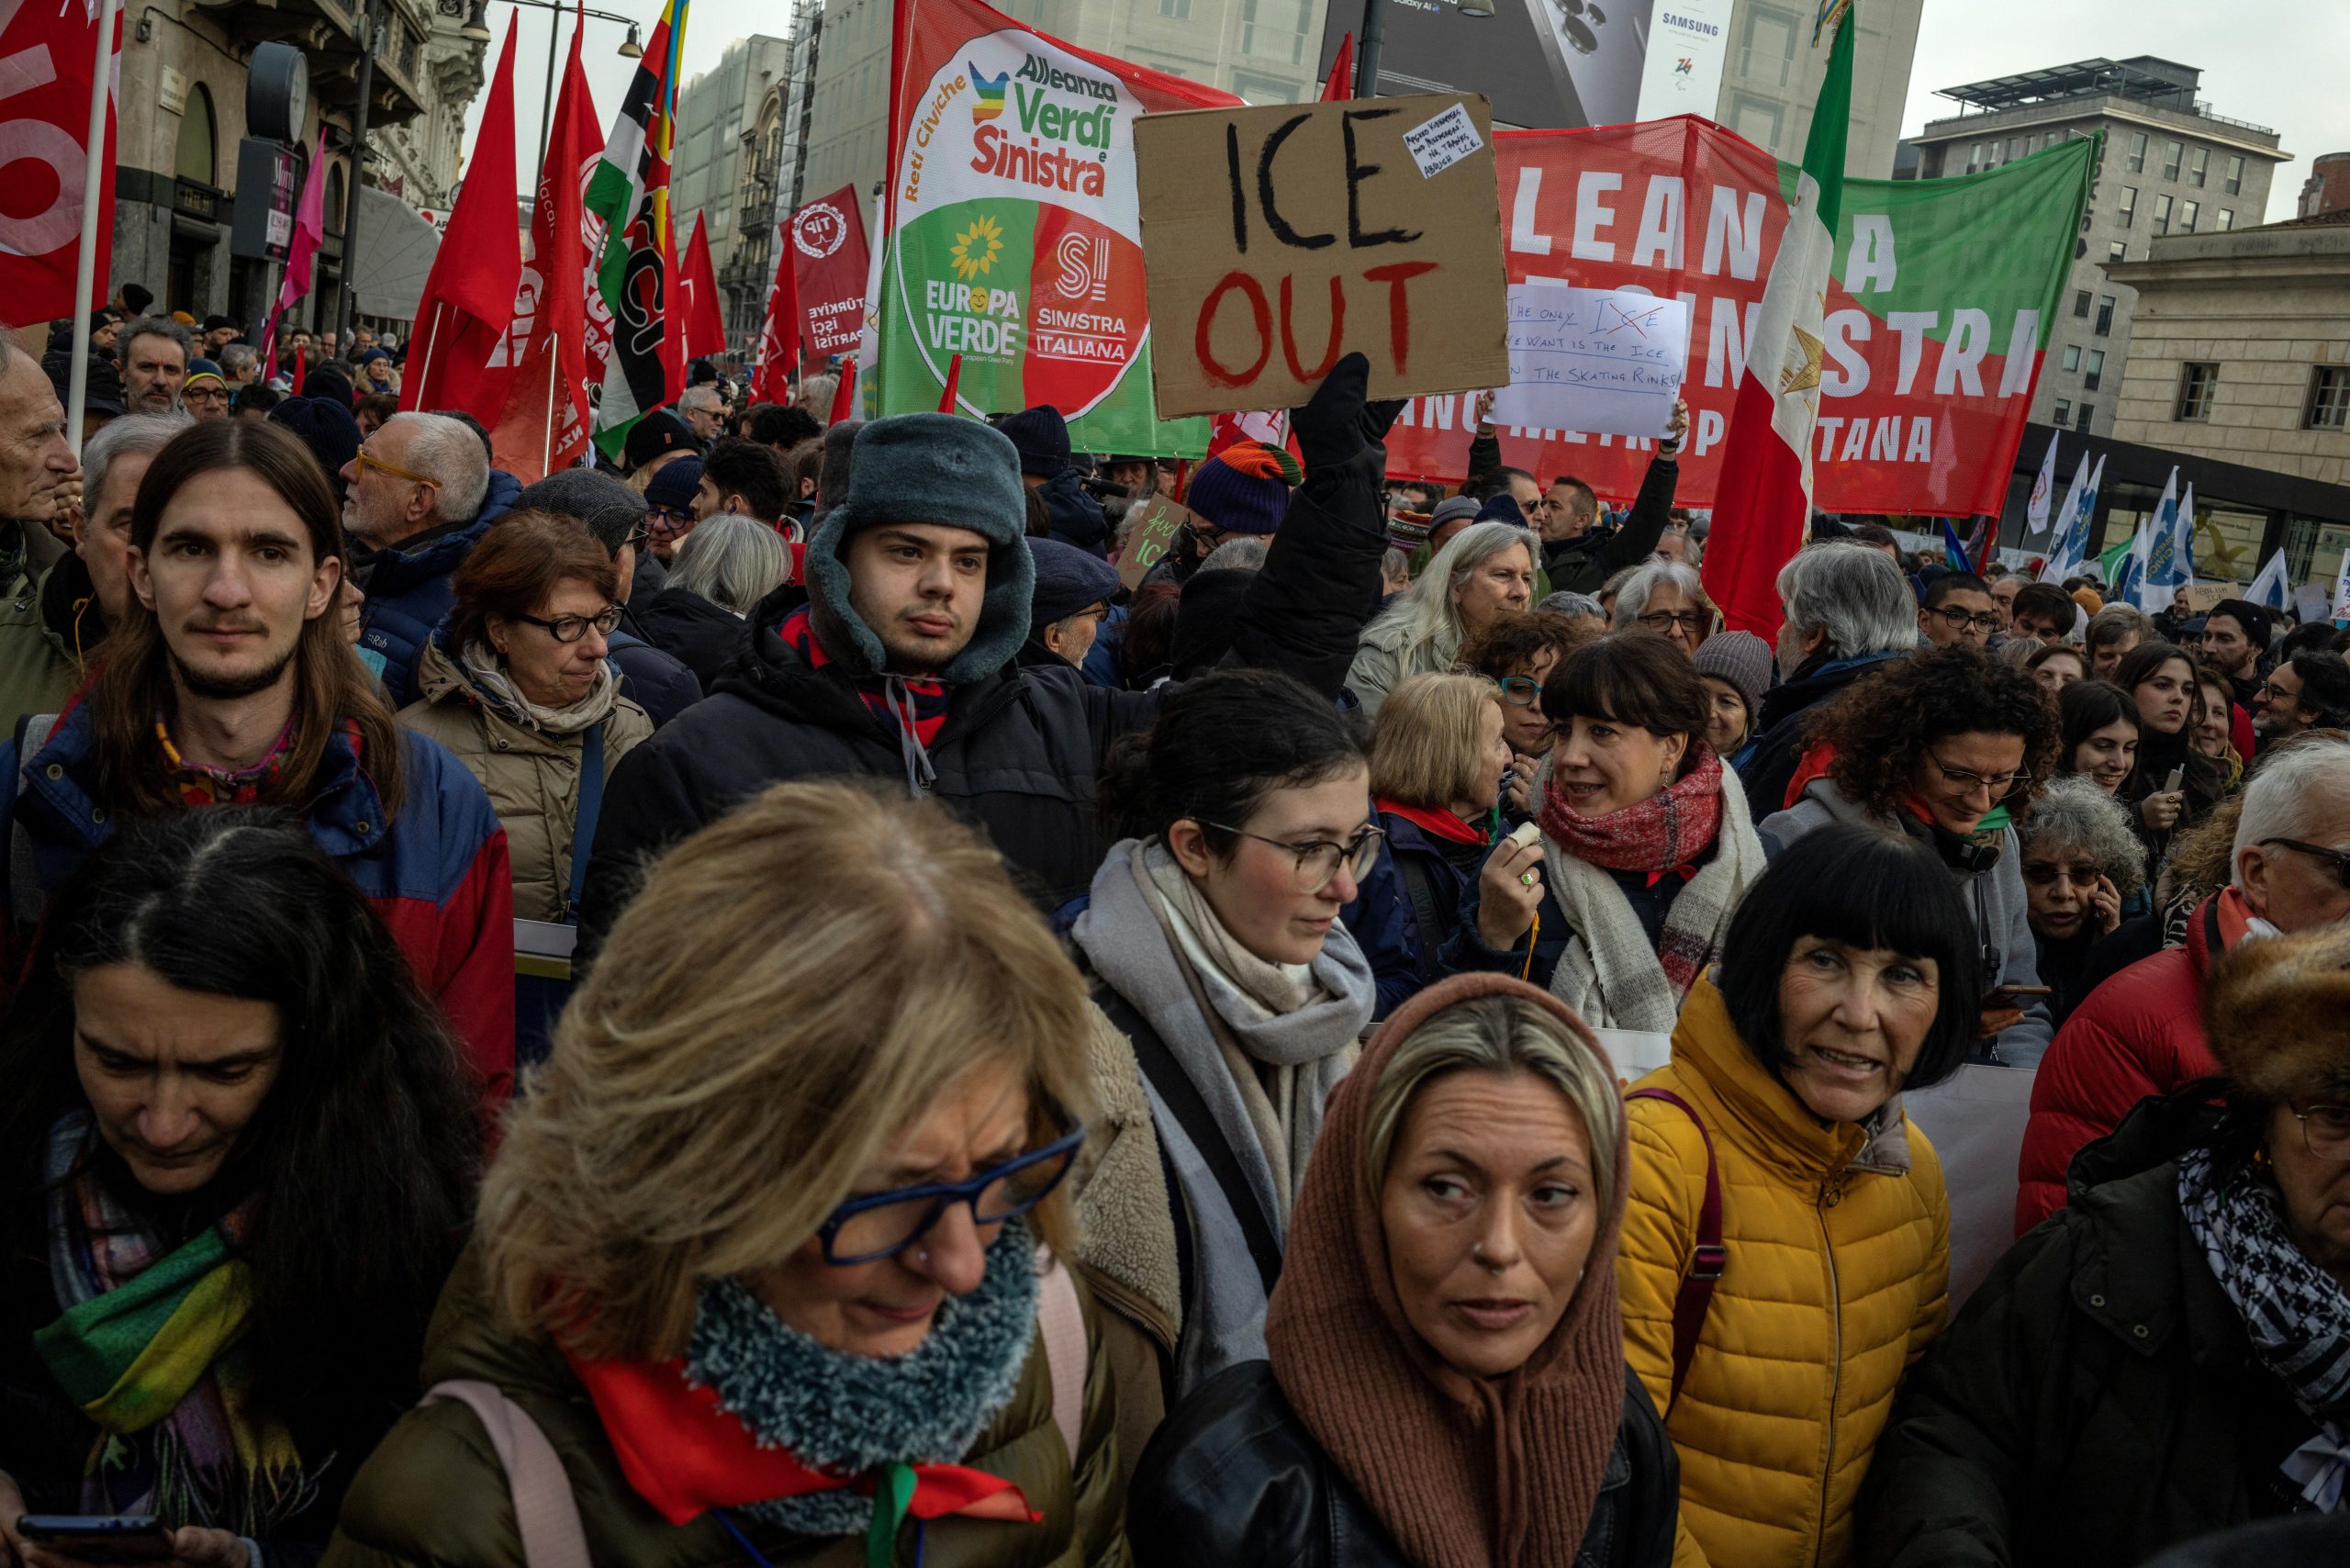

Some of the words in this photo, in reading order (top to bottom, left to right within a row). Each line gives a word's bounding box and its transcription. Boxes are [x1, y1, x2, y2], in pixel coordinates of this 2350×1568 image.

[1662, 13, 1718, 37] SAMSUNG
[1015, 53, 1118, 103] Alleanza
[1014, 82, 1117, 150] Verdi
[905, 150, 923, 203] Reti
[916, 73, 968, 149] Civiche
[970, 124, 1105, 197] Sinistra
[1099, 151, 1107, 162] e
[1227, 106, 1424, 255] ICE
[1508, 297, 1530, 317] THE
[1037, 308, 1126, 334] SINISTRA
[1195, 260, 1442, 388] OUT
[926, 313, 1020, 356] VERDE
[1036, 335, 1126, 360] ITALIANA
[1527, 337, 1565, 347] WANT
[1631, 345, 1666, 358] ICE
[1534, 367, 1561, 379] THE
[1136, 539, 1167, 566] IC
[372, 634, 387, 649] Rab
